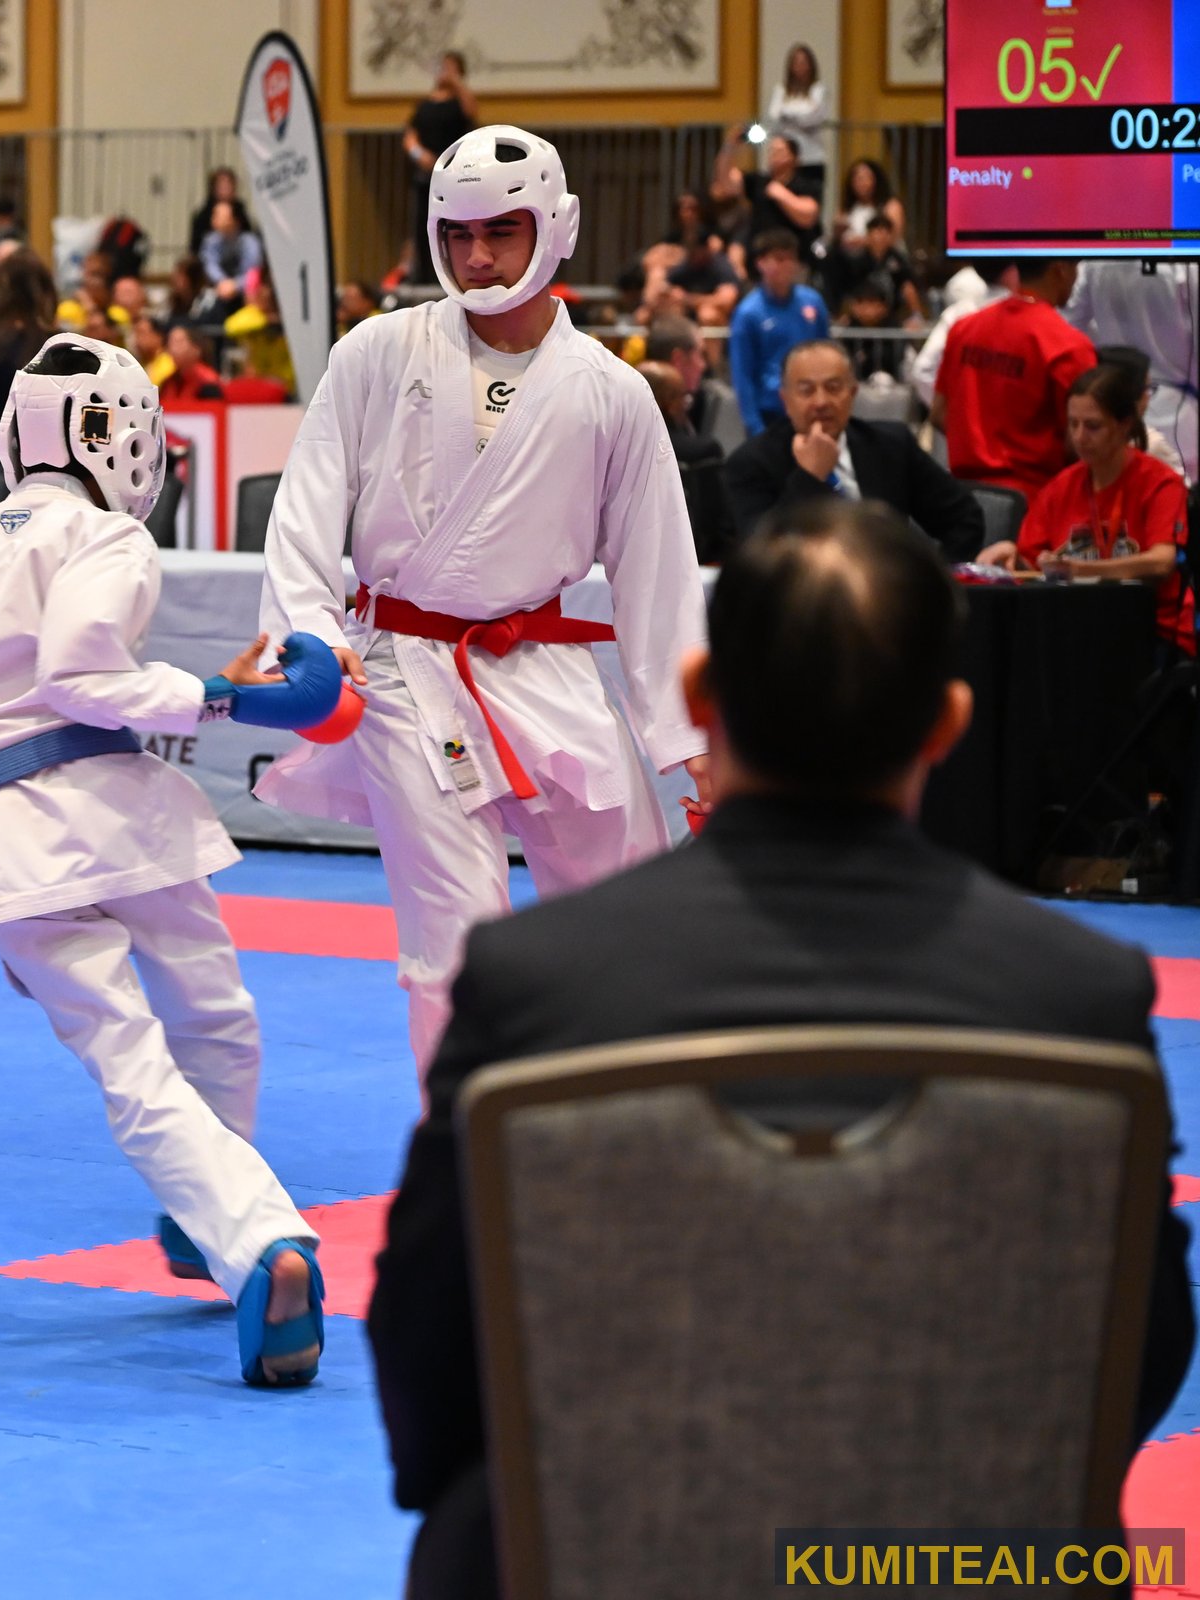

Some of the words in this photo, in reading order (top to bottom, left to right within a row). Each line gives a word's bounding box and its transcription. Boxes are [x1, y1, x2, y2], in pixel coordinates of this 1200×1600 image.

[997, 38, 1077, 103] 05
[1110, 108, 1200, 149] 00:2
[949, 165, 1013, 190] Penalty
[132, 734, 198, 765] ATE
